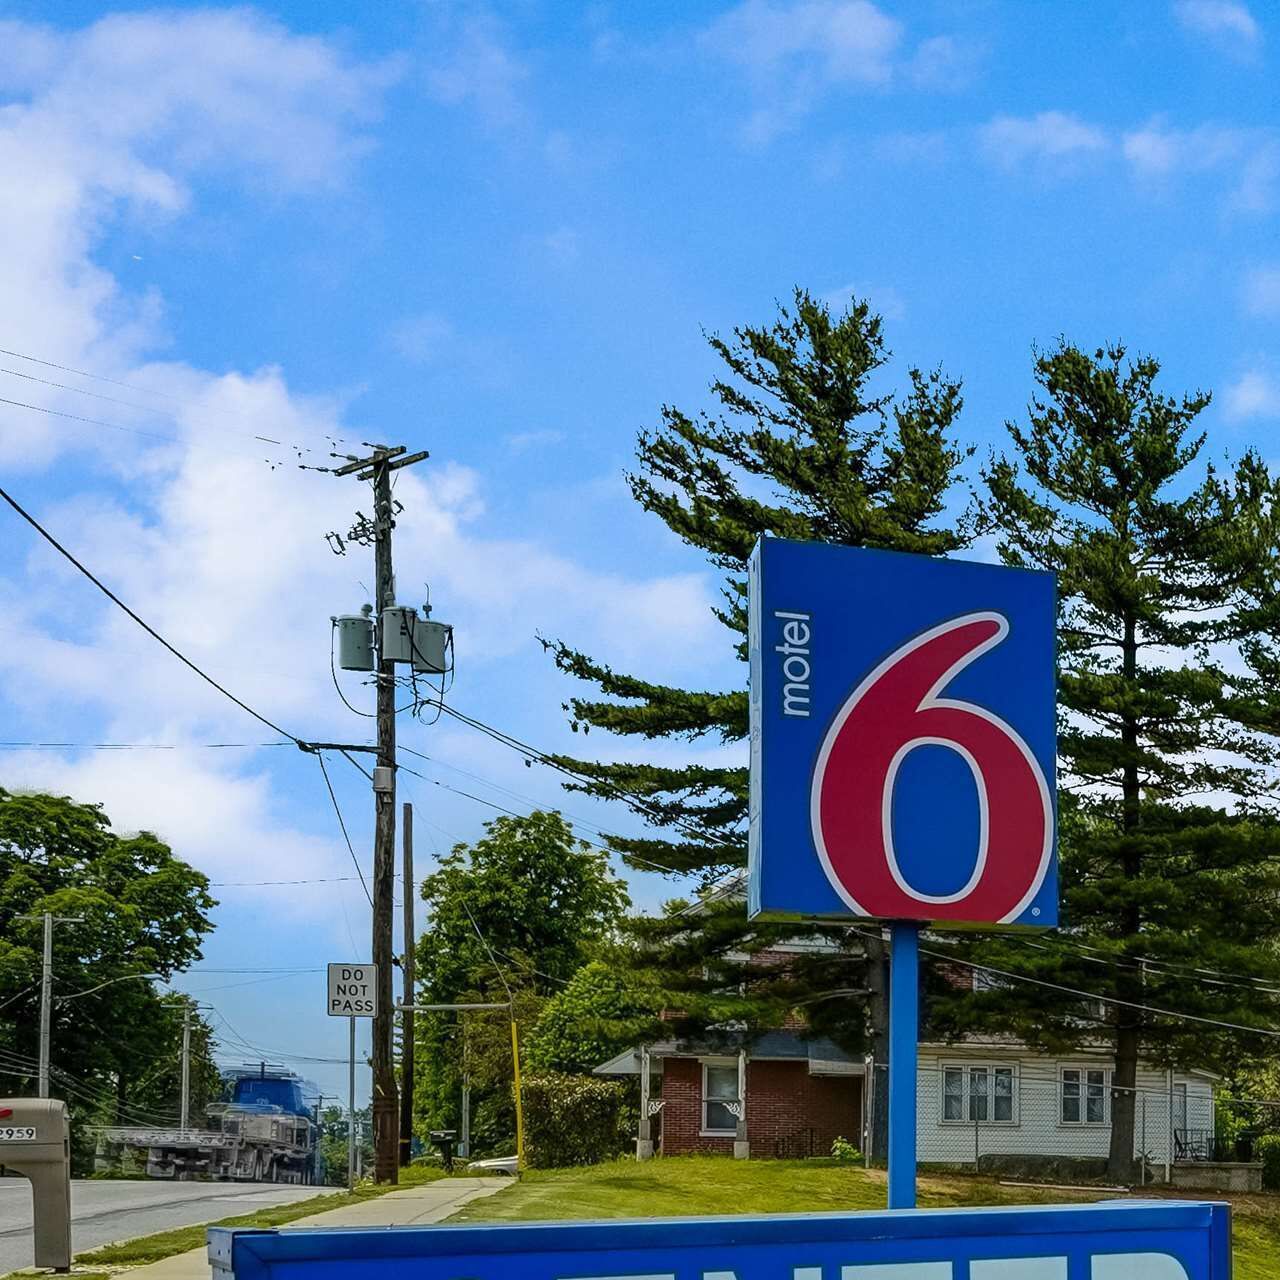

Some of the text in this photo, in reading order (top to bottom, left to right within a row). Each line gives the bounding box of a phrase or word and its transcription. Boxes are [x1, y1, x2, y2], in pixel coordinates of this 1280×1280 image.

[774, 610, 1054, 924] motel 6
[342, 969, 363, 980] DO
[336, 984, 368, 996] NOT
[332, 1000, 373, 1011] PASS
